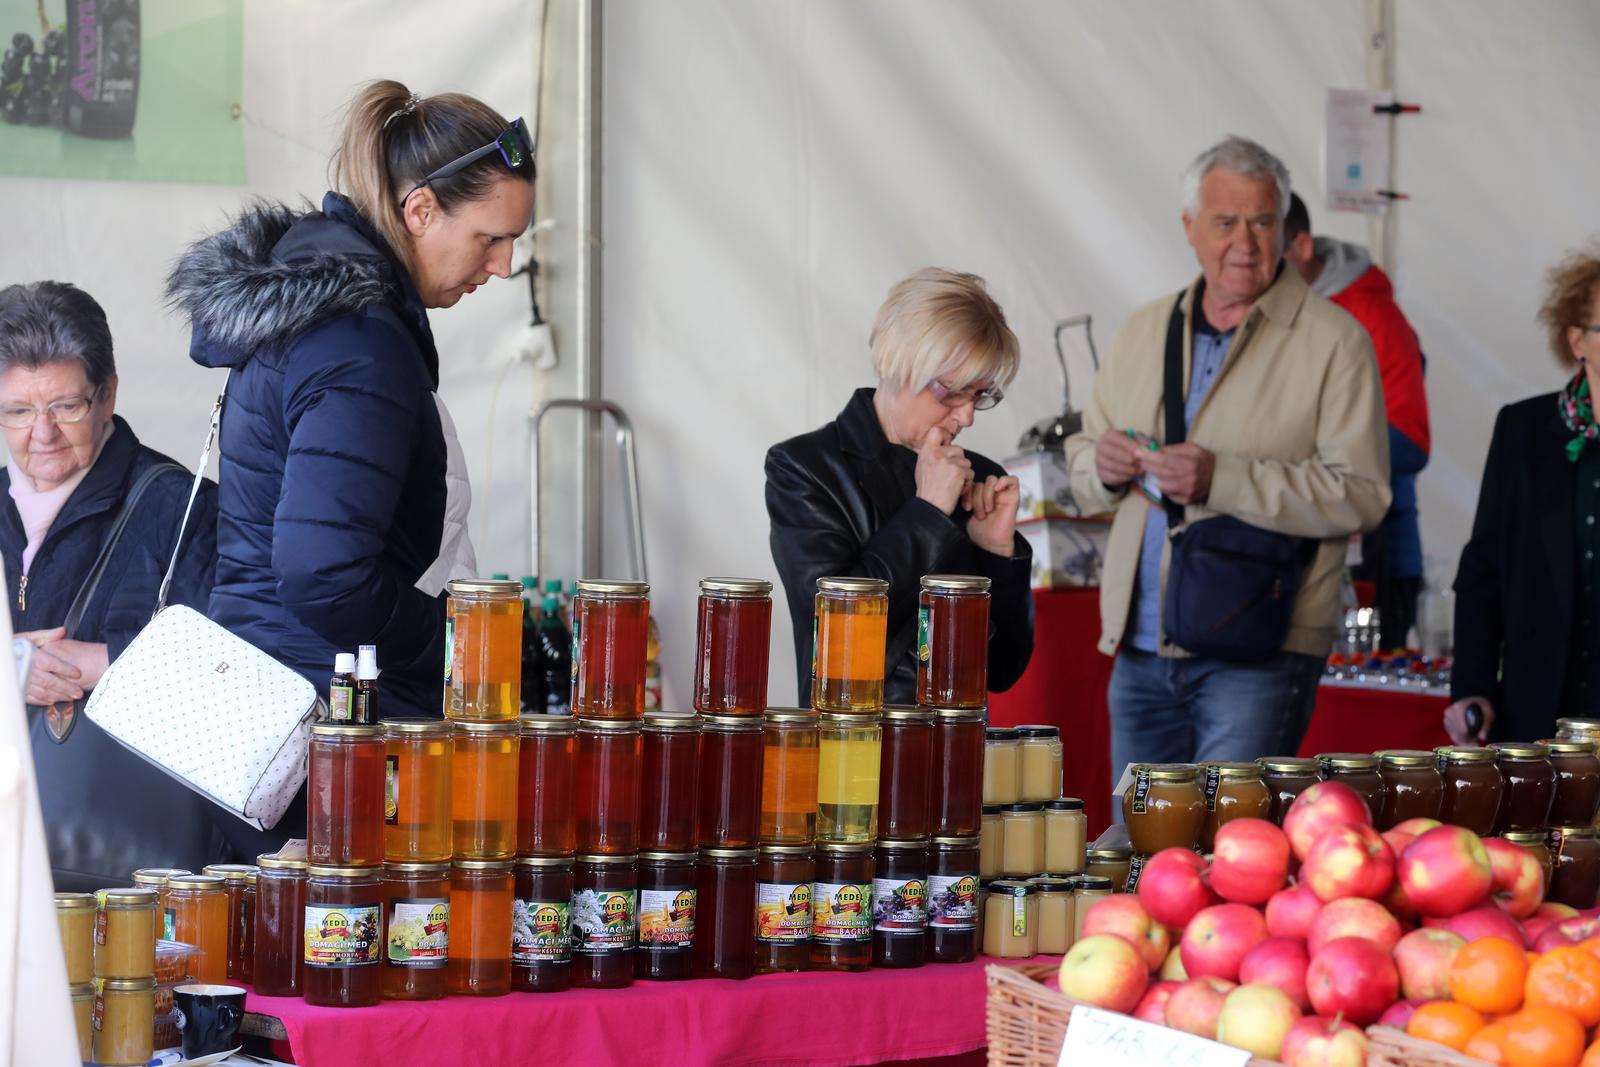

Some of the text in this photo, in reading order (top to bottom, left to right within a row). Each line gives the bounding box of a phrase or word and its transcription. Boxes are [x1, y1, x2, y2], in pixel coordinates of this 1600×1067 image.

[214, 661, 230, 674] B
[834, 893, 863, 901] MEDEL
[602, 903, 629, 911] MEDEL
[427, 912, 450, 921] MEDEL
[322, 919, 351, 927] MEDEL
[839, 927, 870, 935] BAGREM
[347, 941, 368, 949] MED
